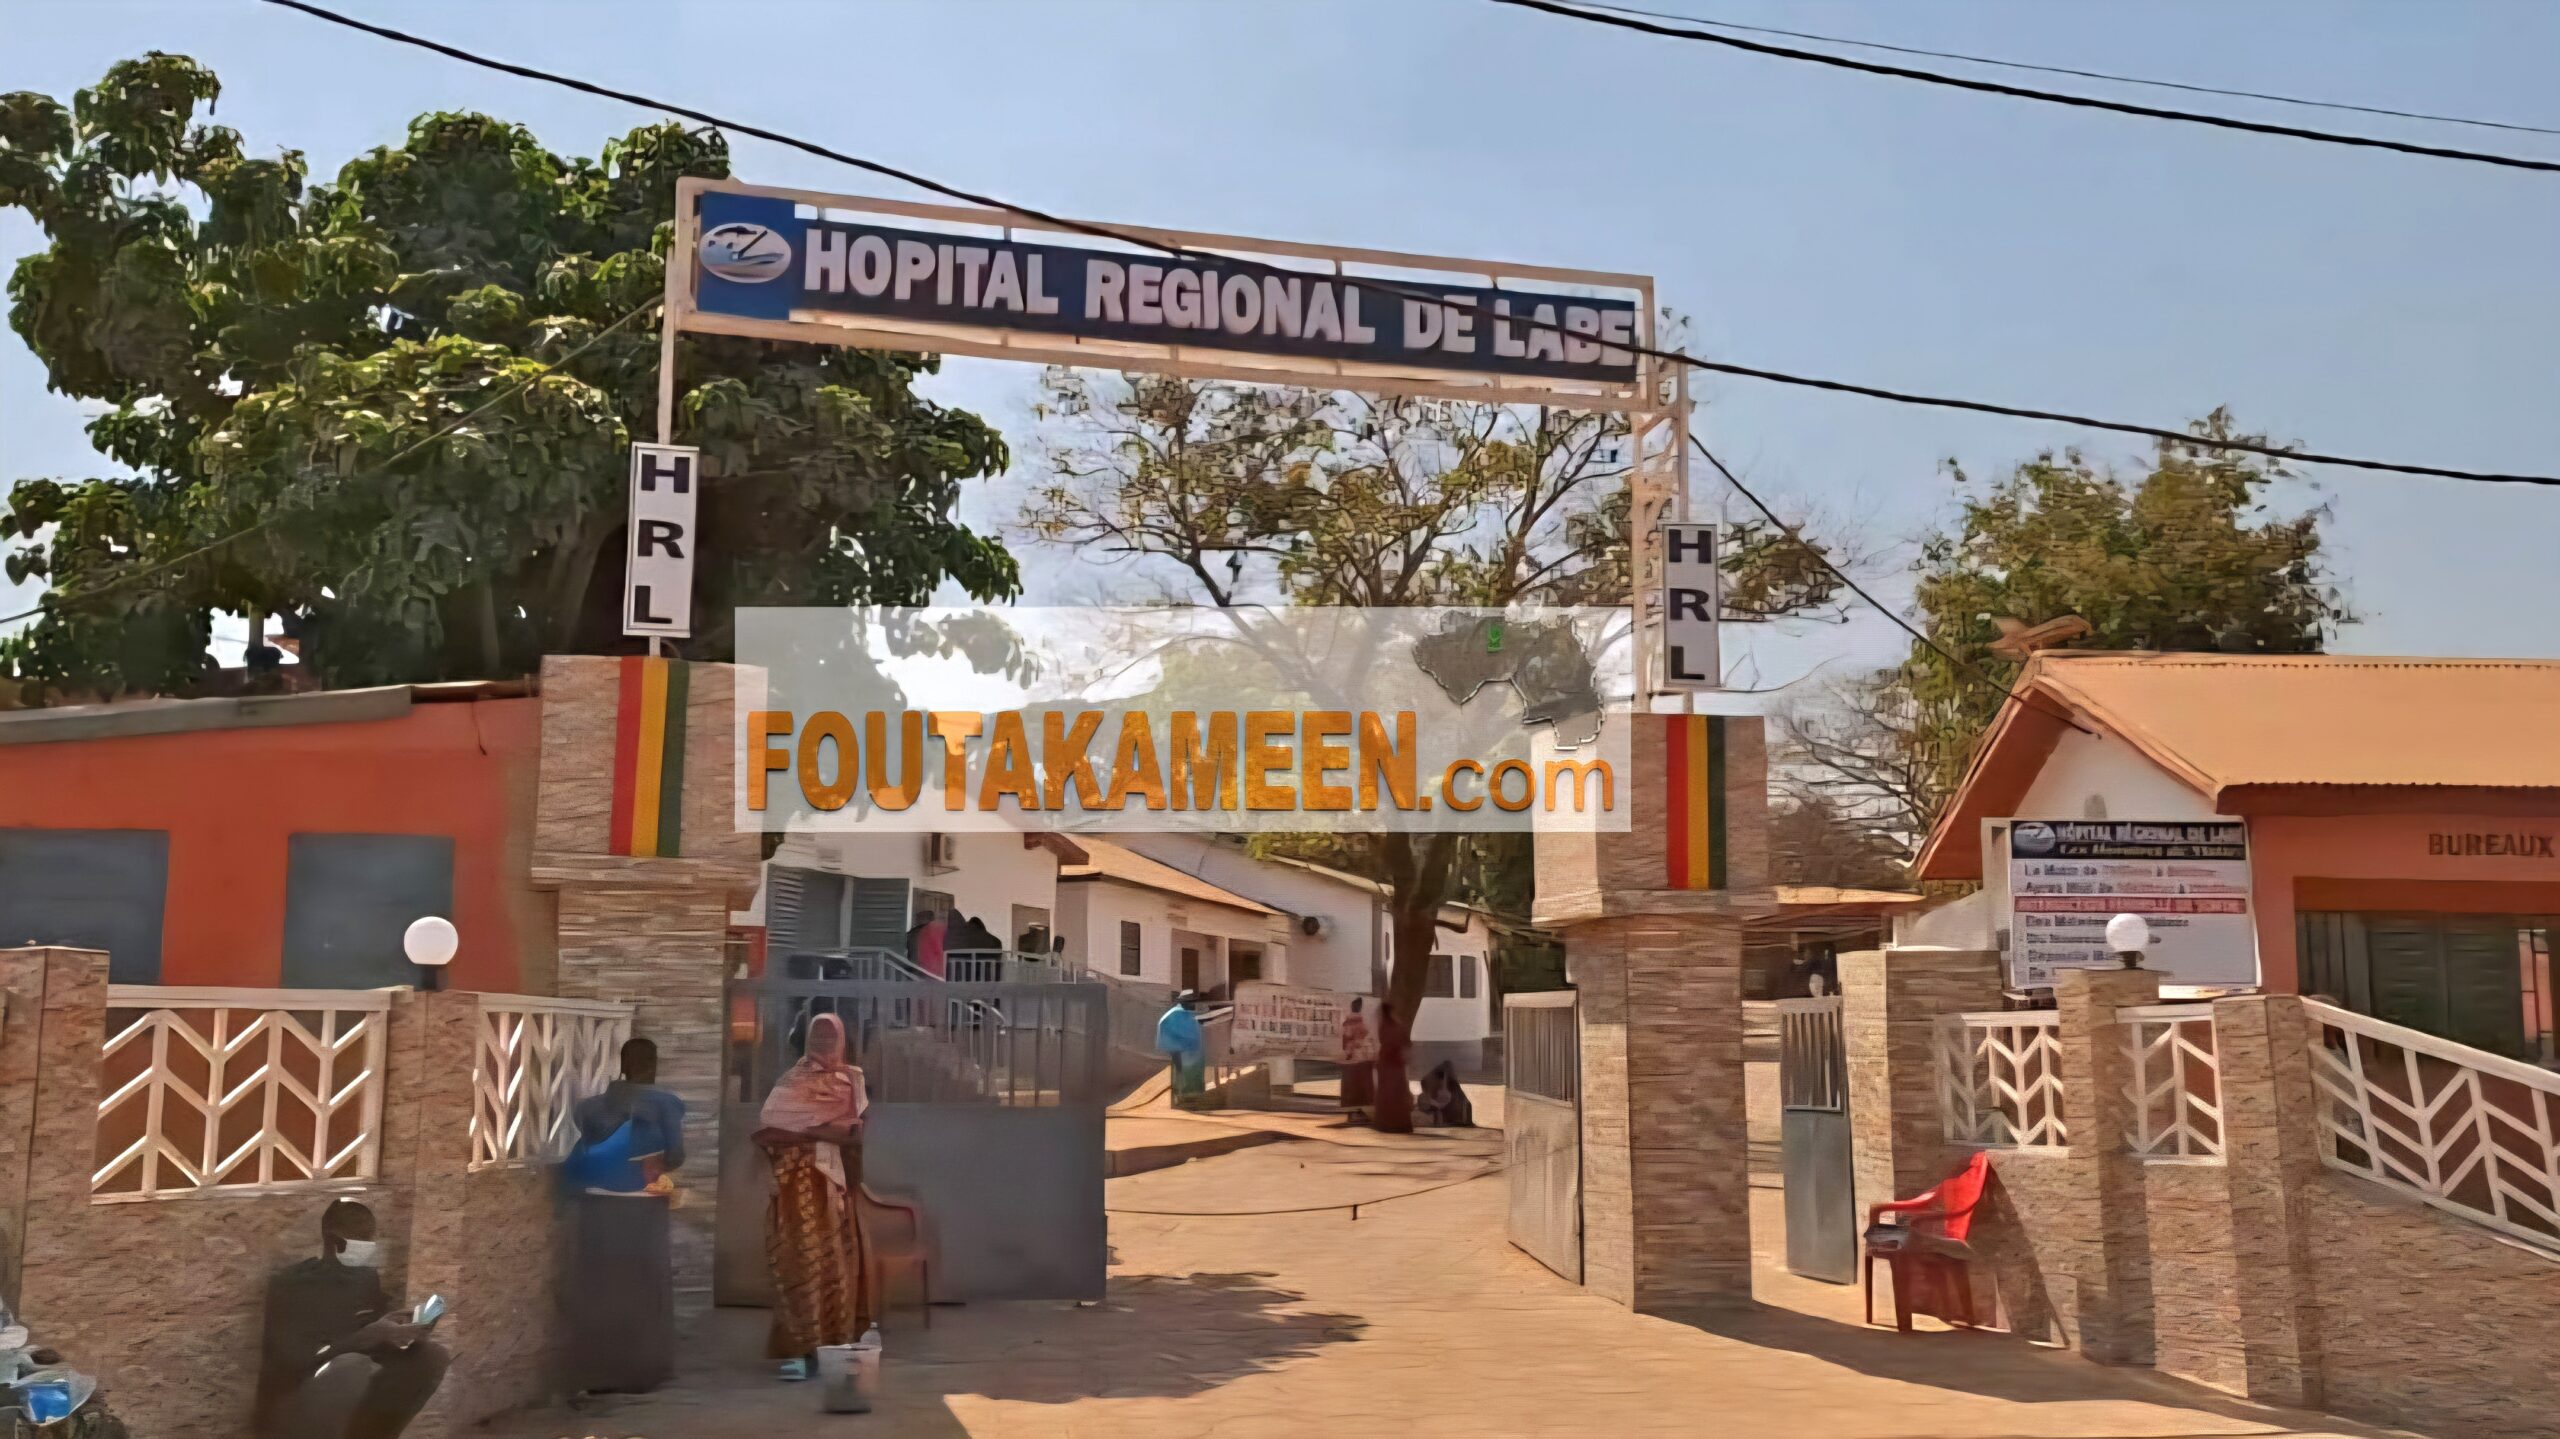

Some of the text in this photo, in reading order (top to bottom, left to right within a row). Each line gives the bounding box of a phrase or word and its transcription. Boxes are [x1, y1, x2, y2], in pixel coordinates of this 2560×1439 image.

[804, 228, 1634, 367] HOPITAL REGIONAL DE LABE
[633, 453, 691, 625] HRL
[1668, 528, 1712, 681] HRL
[2428, 832, 2555, 858] BUREAUX
